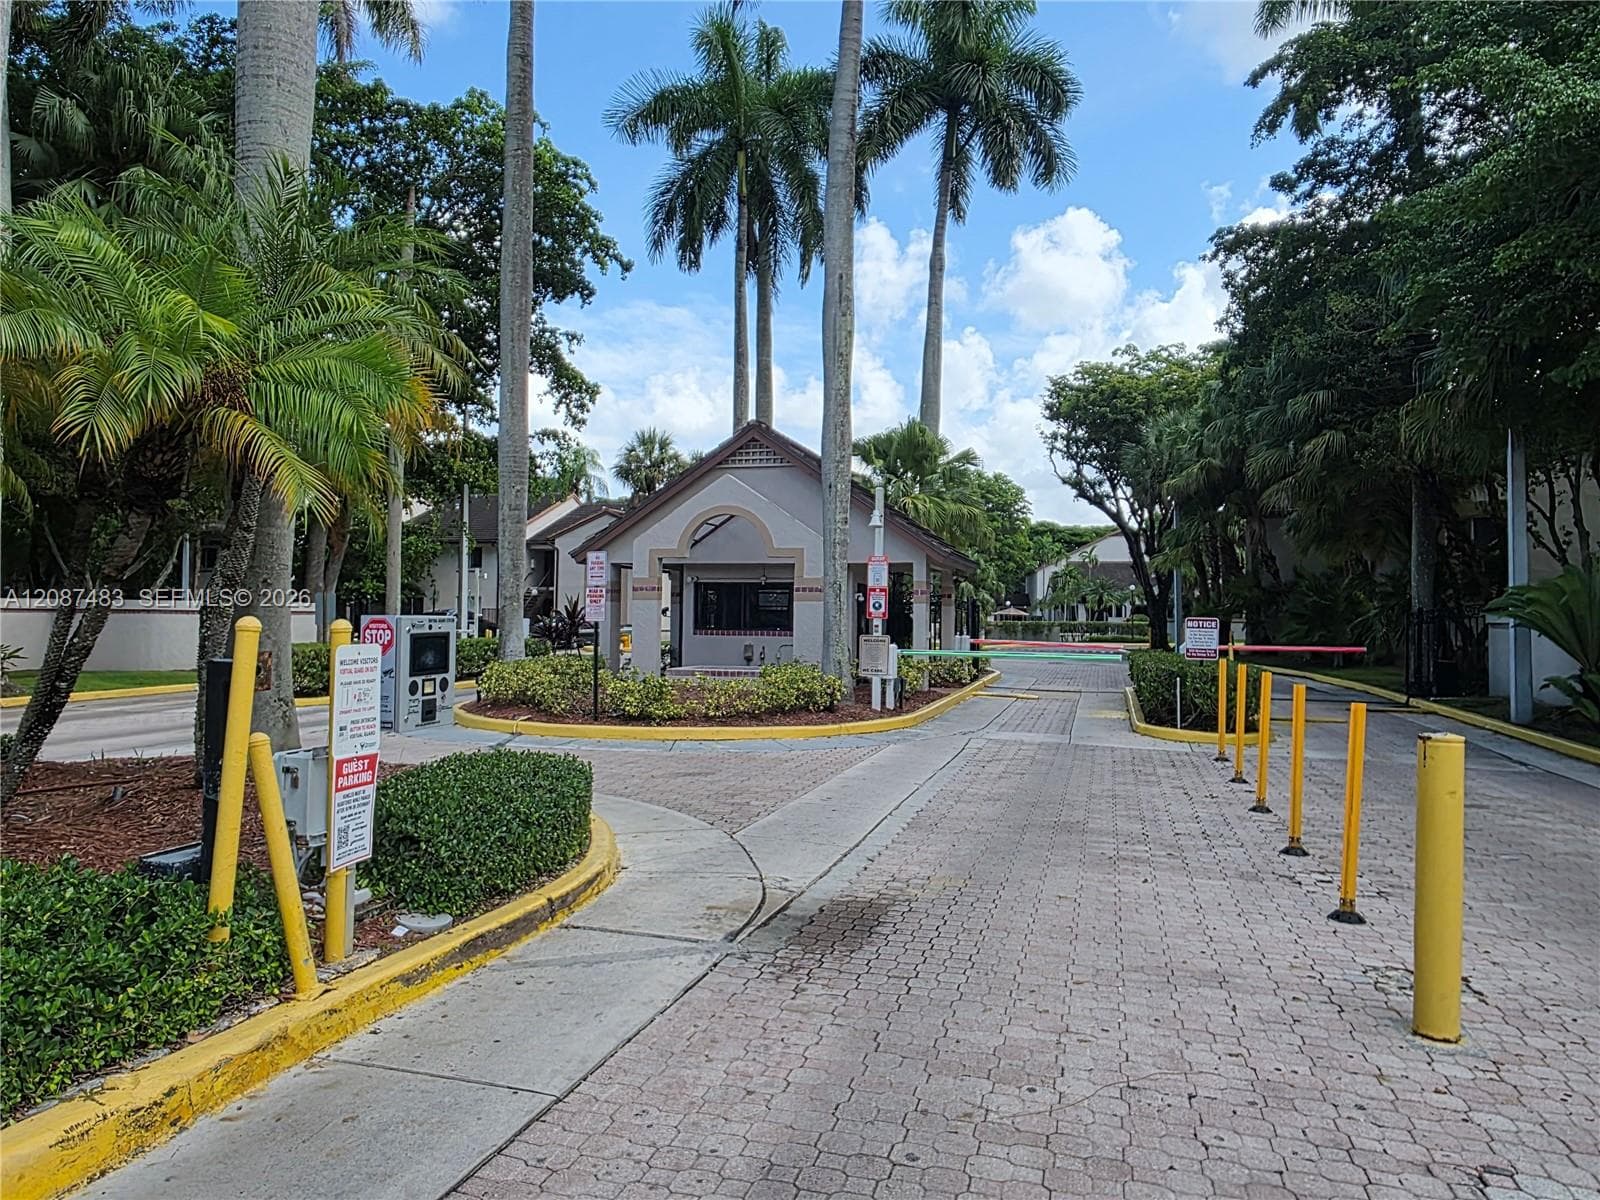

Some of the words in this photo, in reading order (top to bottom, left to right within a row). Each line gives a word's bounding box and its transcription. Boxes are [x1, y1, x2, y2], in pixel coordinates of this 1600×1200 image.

[1187, 620, 1217, 628] NOTICE
[364, 629, 392, 645] STOP
[340, 658, 359, 666] WELCOME
[360, 657, 379, 665] VISITORS
[342, 759, 370, 775] GUEST
[337, 770, 373, 788] PARKING
